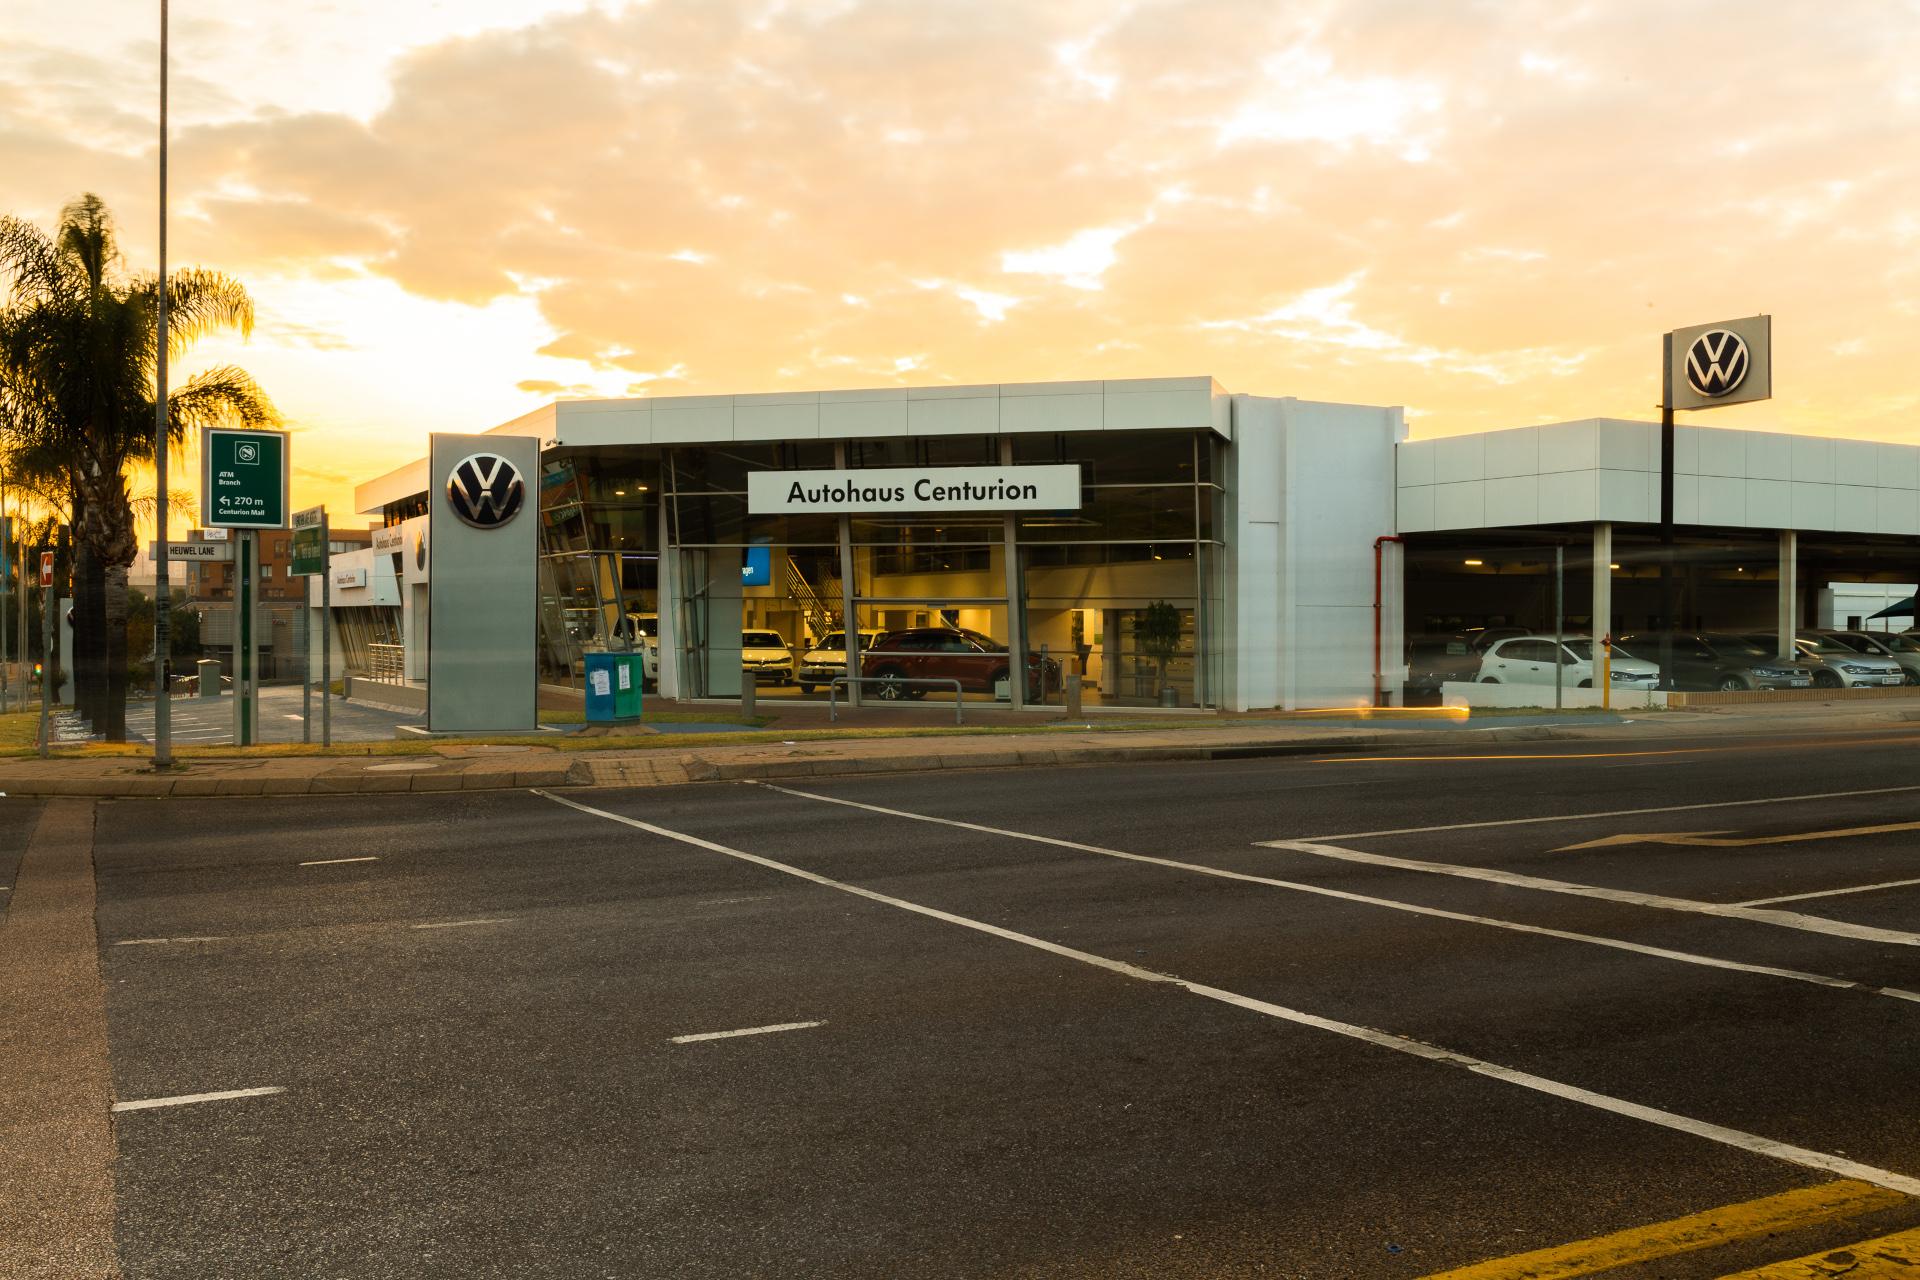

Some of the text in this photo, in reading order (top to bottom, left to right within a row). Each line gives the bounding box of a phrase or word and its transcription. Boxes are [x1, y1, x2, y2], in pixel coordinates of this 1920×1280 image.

[787, 478, 1037, 503] Autohaus Centurion
[234, 497, 263, 506] 270 m
[169, 546, 215, 556] HEUWEL LANE
